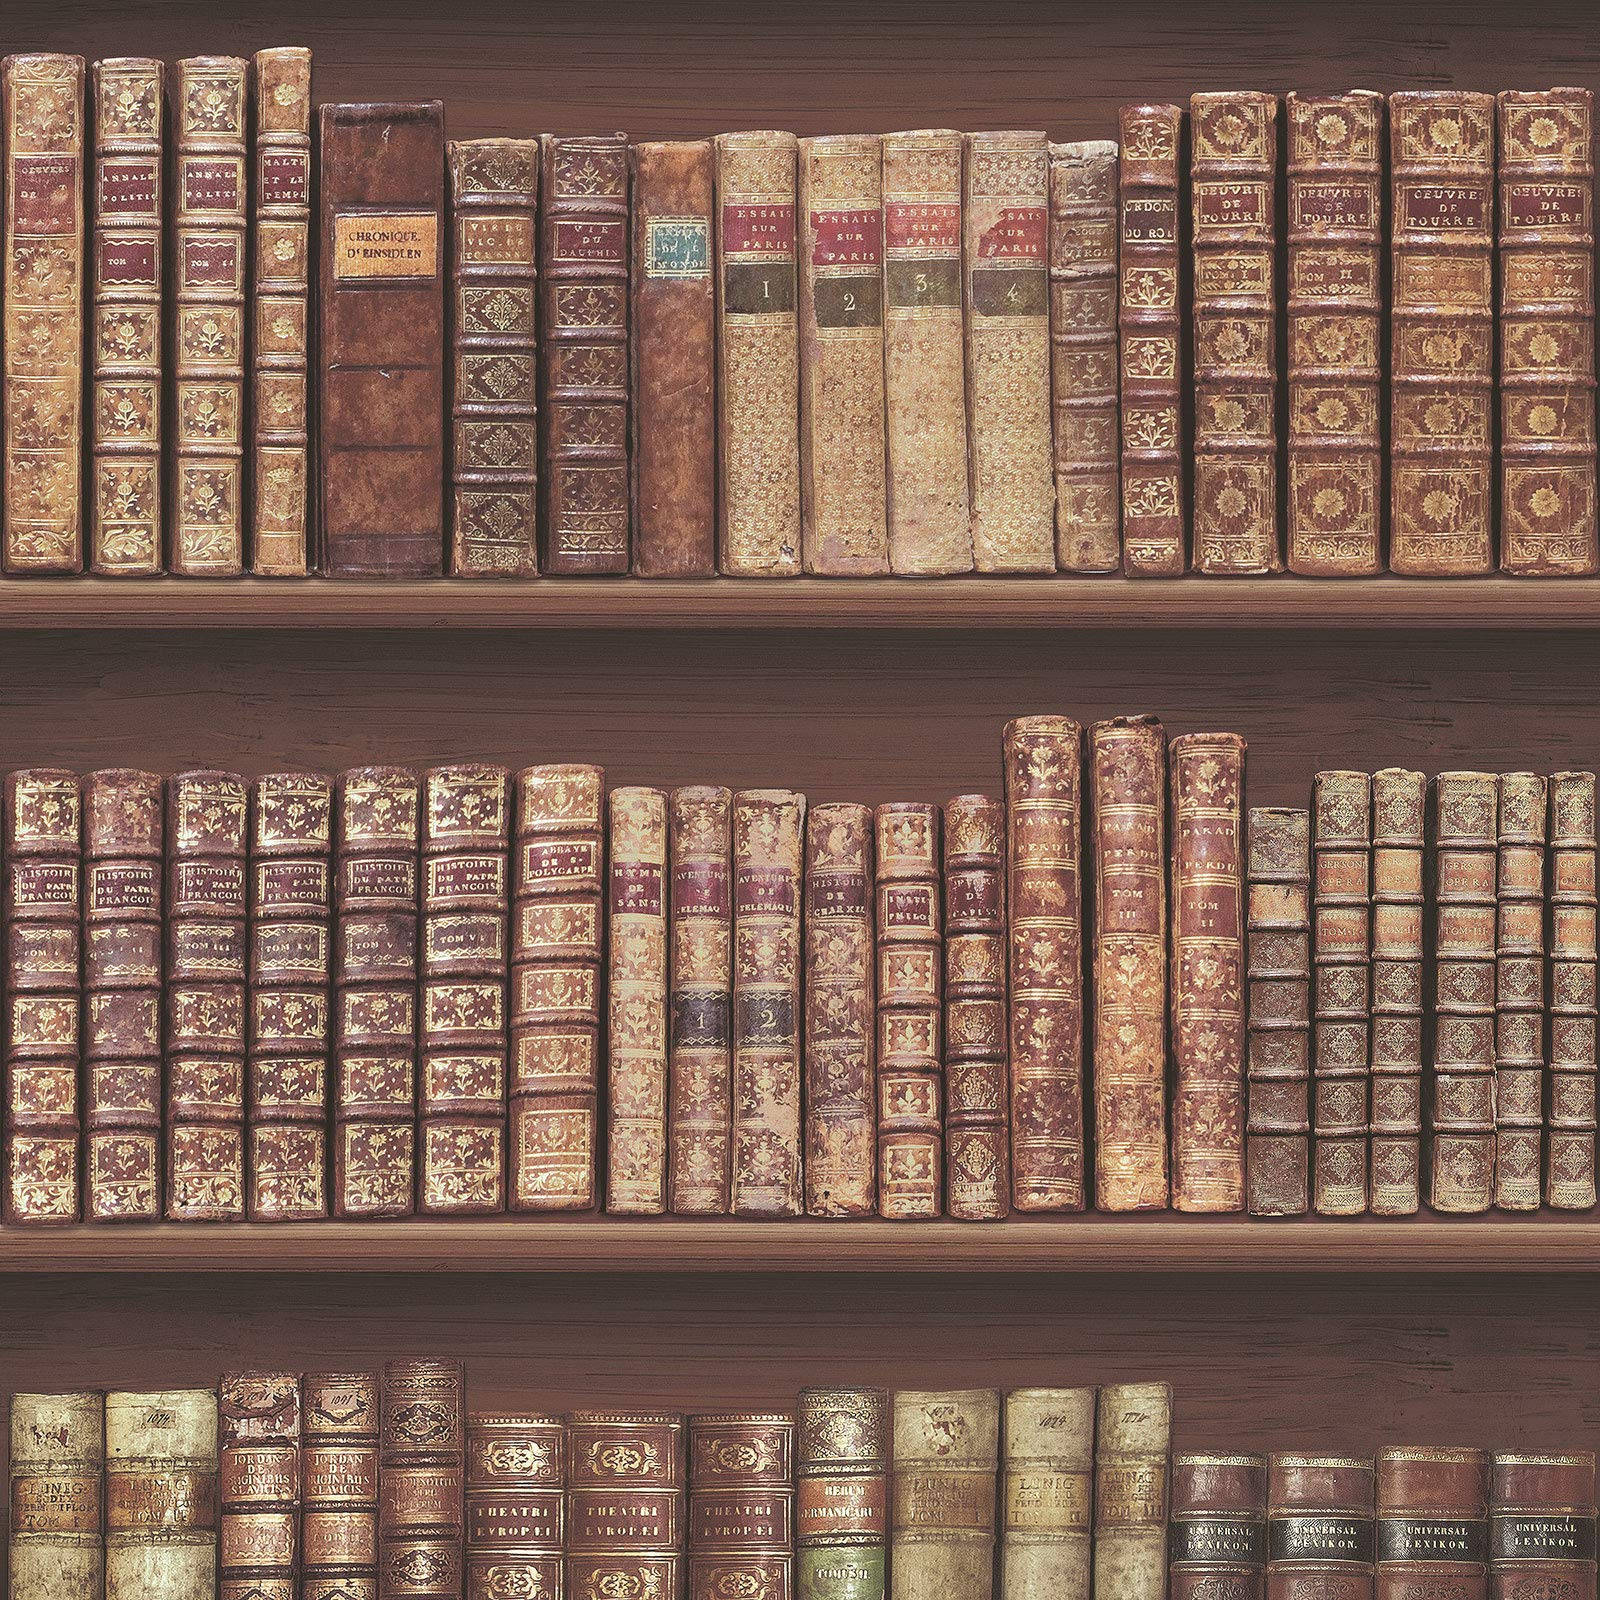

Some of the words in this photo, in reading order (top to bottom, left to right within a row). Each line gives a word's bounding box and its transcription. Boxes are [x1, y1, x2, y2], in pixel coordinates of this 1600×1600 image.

[1221, 199, 1241, 209] DE
[1439, 203, 1458, 213] DE
[1540, 201, 1560, 210] DE
[737, 209, 792, 218] ESSAIS
[897, 208, 957, 217] ESSAIS
[818, 214, 876, 223] ESSAIS
[574, 225, 609, 234] VIE
[751, 225, 778, 233] SUR
[582, 236, 602, 244] DU
[836, 233, 864, 241] SUR
[906, 237, 954, 246] PARIS
[743, 241, 788, 249] PARIS
[987, 243, 1038, 257] PARIS
[827, 252, 875, 261] PARIS
[191, 259, 210, 267] TOM
[1339, 269, 1353, 280] II
[914, 273, 928, 292] 3
[1007, 283, 1018, 301] 4
[843, 293, 856, 311] 2
[187, 879, 204, 888] DU
[354, 876, 369, 884] DU
[437, 875, 454, 883] DU
[22, 882, 36, 890] DU
[266, 881, 281, 889] DU
[628, 884, 645, 893] DE
[1025, 880, 1056, 889] TOM
[97, 886, 113, 894] DU
[757, 887, 775, 896] DE
[1112, 889, 1143, 898] TOM
[825, 891, 845, 901] DE
[1188, 901, 1219, 910] TOM
[1119, 910, 1137, 919] III
[1201, 919, 1214, 927] II
[440, 934, 465, 944] TOM
[184, 942, 209, 950] TOM
[264, 943, 290, 953] TOM
[355, 941, 379, 949] TOM
[697, 1013, 706, 1029] 1
[760, 1009, 777, 1028] 2
[315, 1454, 363, 1465] JORDAN
[247, 1464, 265, 1474] DE
[329, 1464, 348, 1474] DE
[476, 1506, 549, 1517] THEATRI
[586, 1506, 658, 1517] THEATRI
[704, 1506, 772, 1516] THEATRI
[1188, 1526, 1252, 1536] UNIVERSAL
[1293, 1525, 1357, 1536] UNIVERSAL
[1406, 1526, 1469, 1536] UNIVERSAL
[1515, 1523, 1578, 1533] UNIVERSAL
